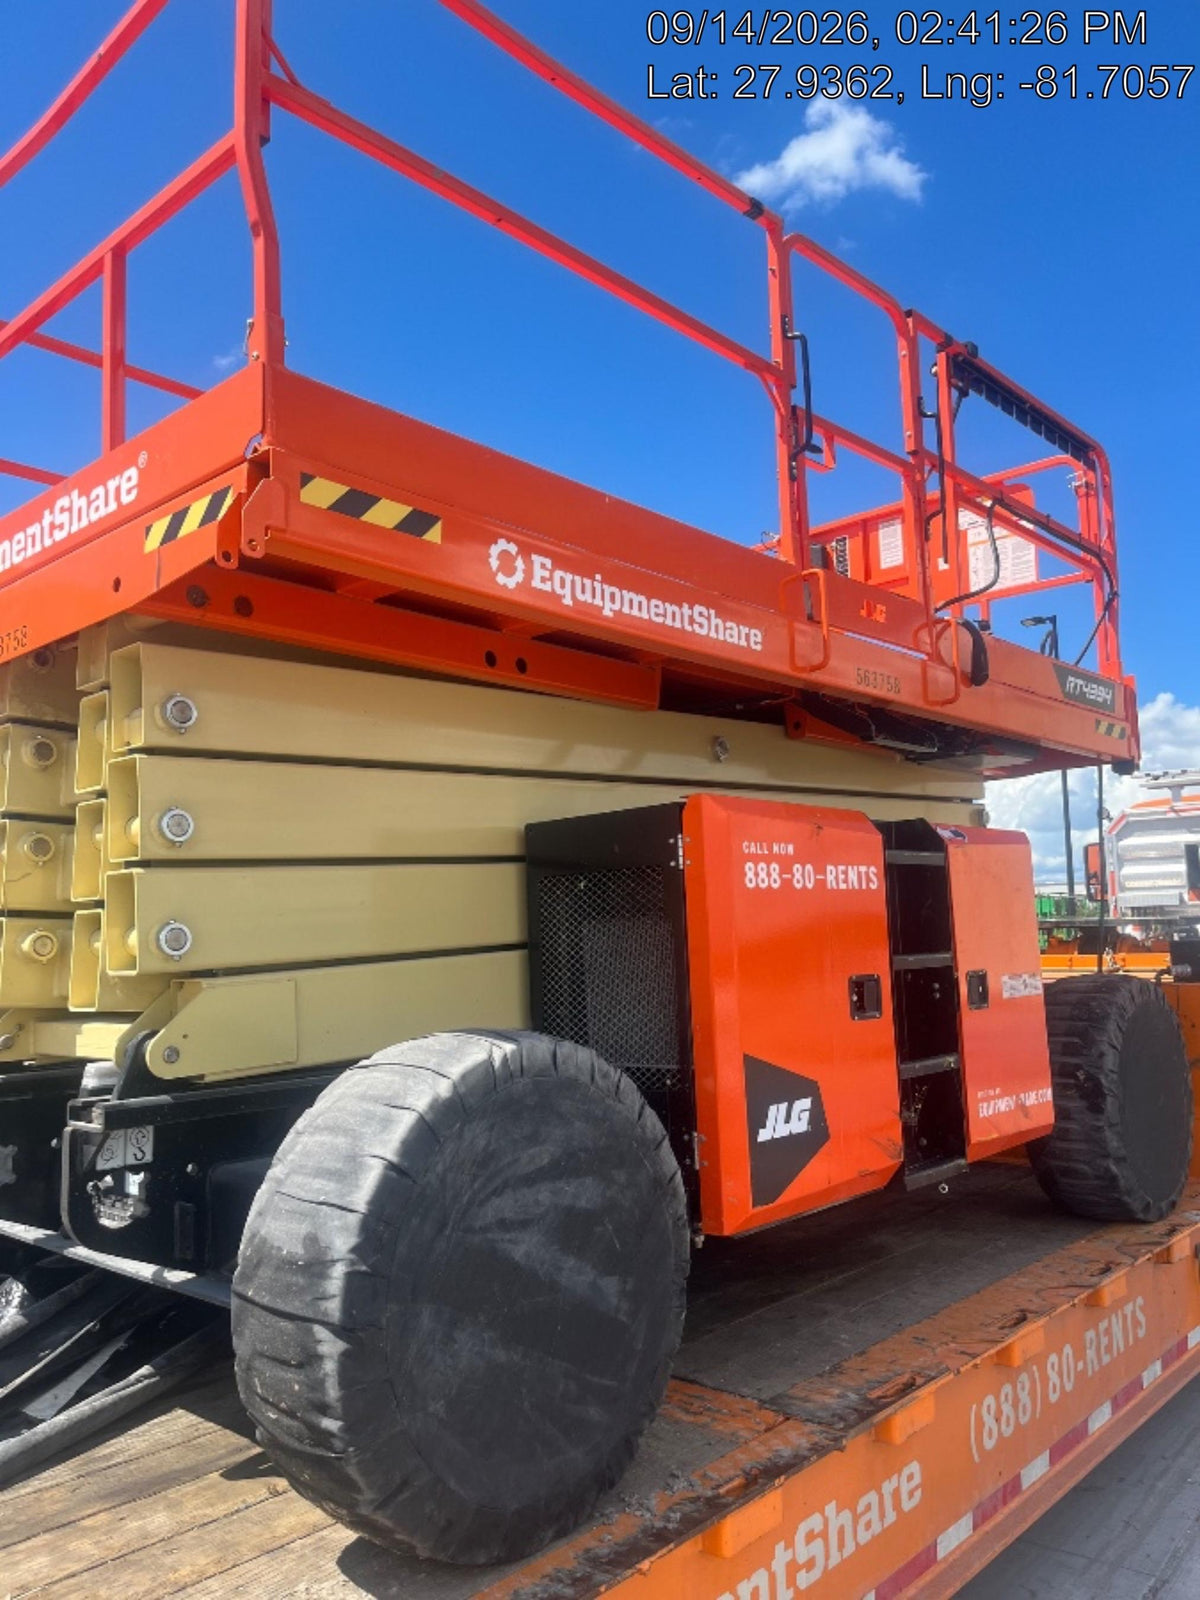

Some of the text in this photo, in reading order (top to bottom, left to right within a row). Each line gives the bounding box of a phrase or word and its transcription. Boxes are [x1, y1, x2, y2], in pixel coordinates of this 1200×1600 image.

[531, 553, 763, 651] EquipmentShare
[742, 841, 795, 856] CALL NOW
[744, 861, 879, 890] 888-80-RENTS
[757, 1096, 813, 1142] JLG
[970, 1296, 1147, 1463] (888) 80-RENTS
[716, 1459, 922, 1600] ntShare
